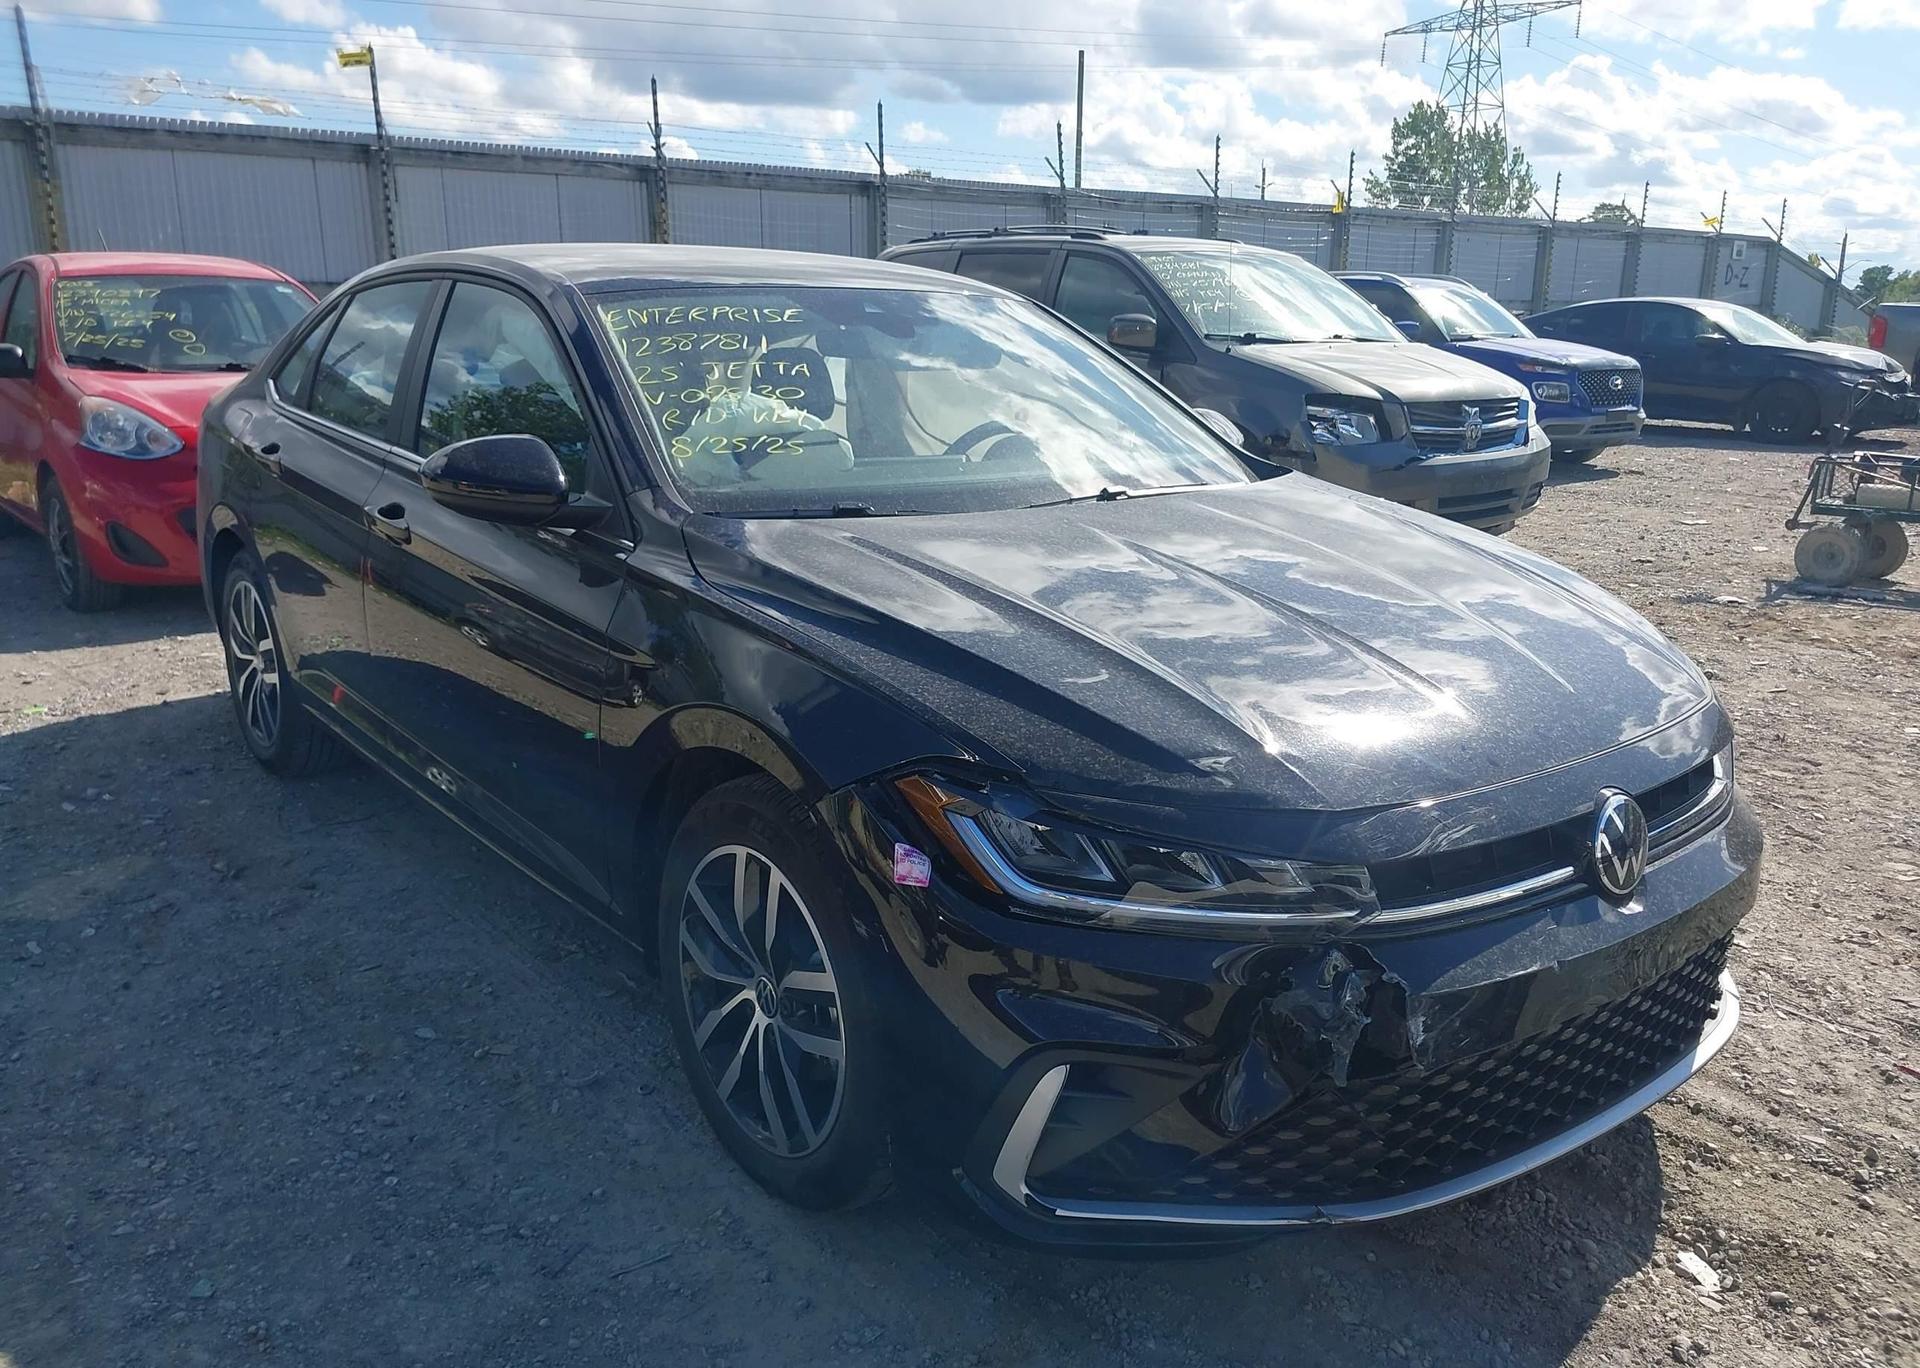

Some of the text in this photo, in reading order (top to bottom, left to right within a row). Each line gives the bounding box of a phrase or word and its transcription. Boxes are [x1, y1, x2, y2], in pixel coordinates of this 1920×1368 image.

[606, 306, 804, 332] ENTERPRISE
[701, 360, 811, 381] JETTA
[671, 434, 806, 458] 8/25/25
